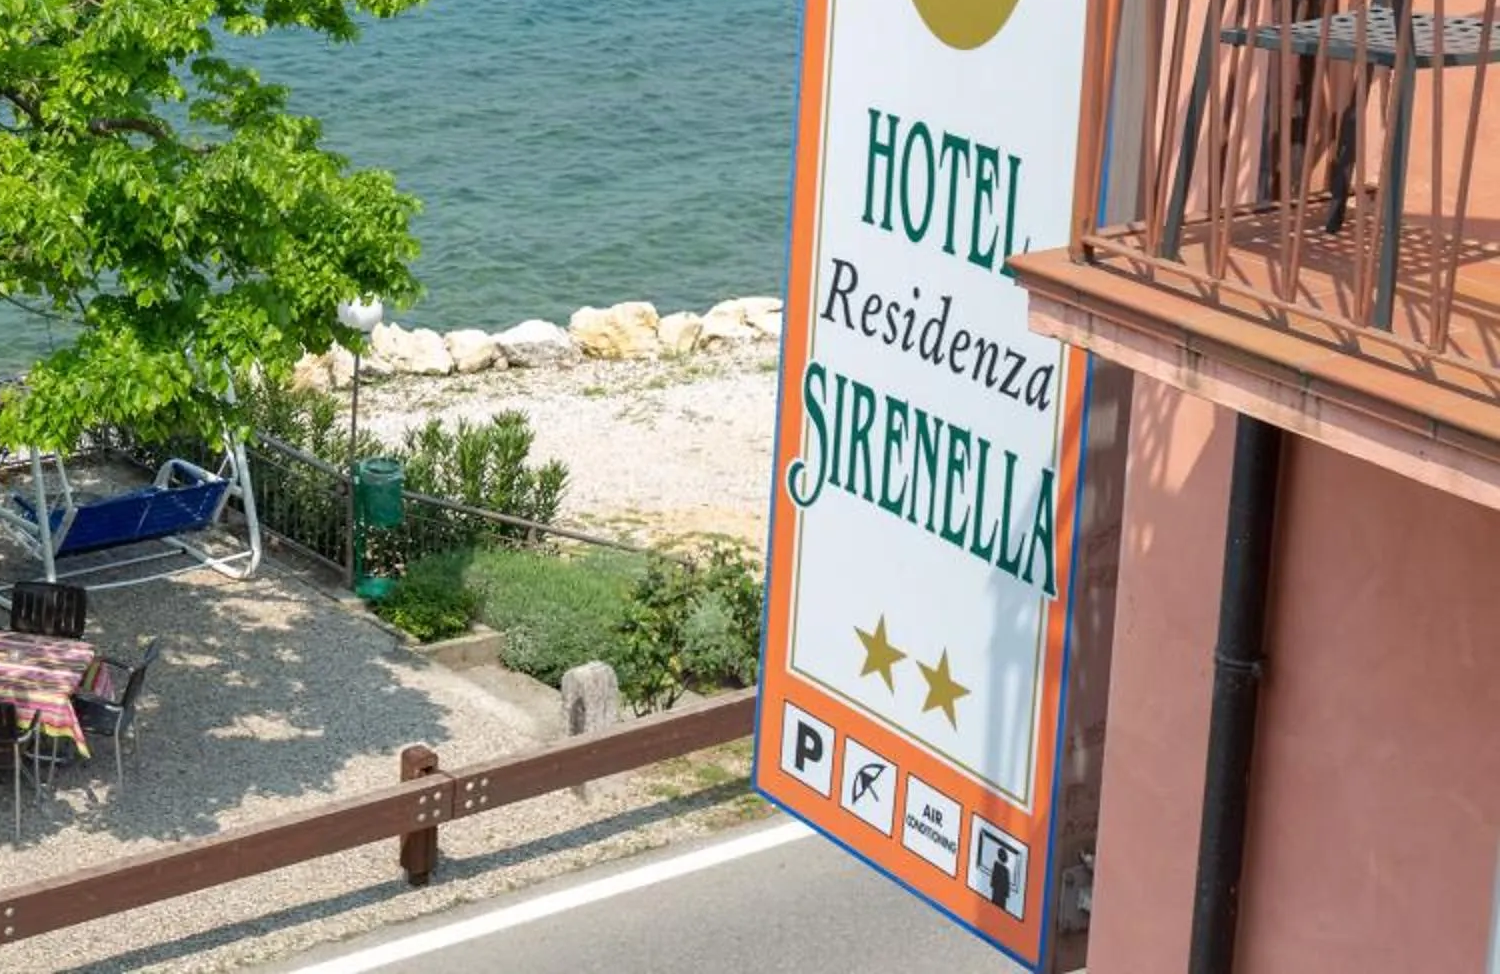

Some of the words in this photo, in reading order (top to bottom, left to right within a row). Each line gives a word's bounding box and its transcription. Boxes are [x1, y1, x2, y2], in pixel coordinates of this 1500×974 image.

[861, 107, 1029, 280] HOTEL
[820, 257, 1054, 412] Residenza
[787, 361, 1056, 596] SIRENELLA
[794, 719, 824, 773] P
[906, 814, 957, 856] CONDITIONING
[922, 803, 944, 828] AIR
